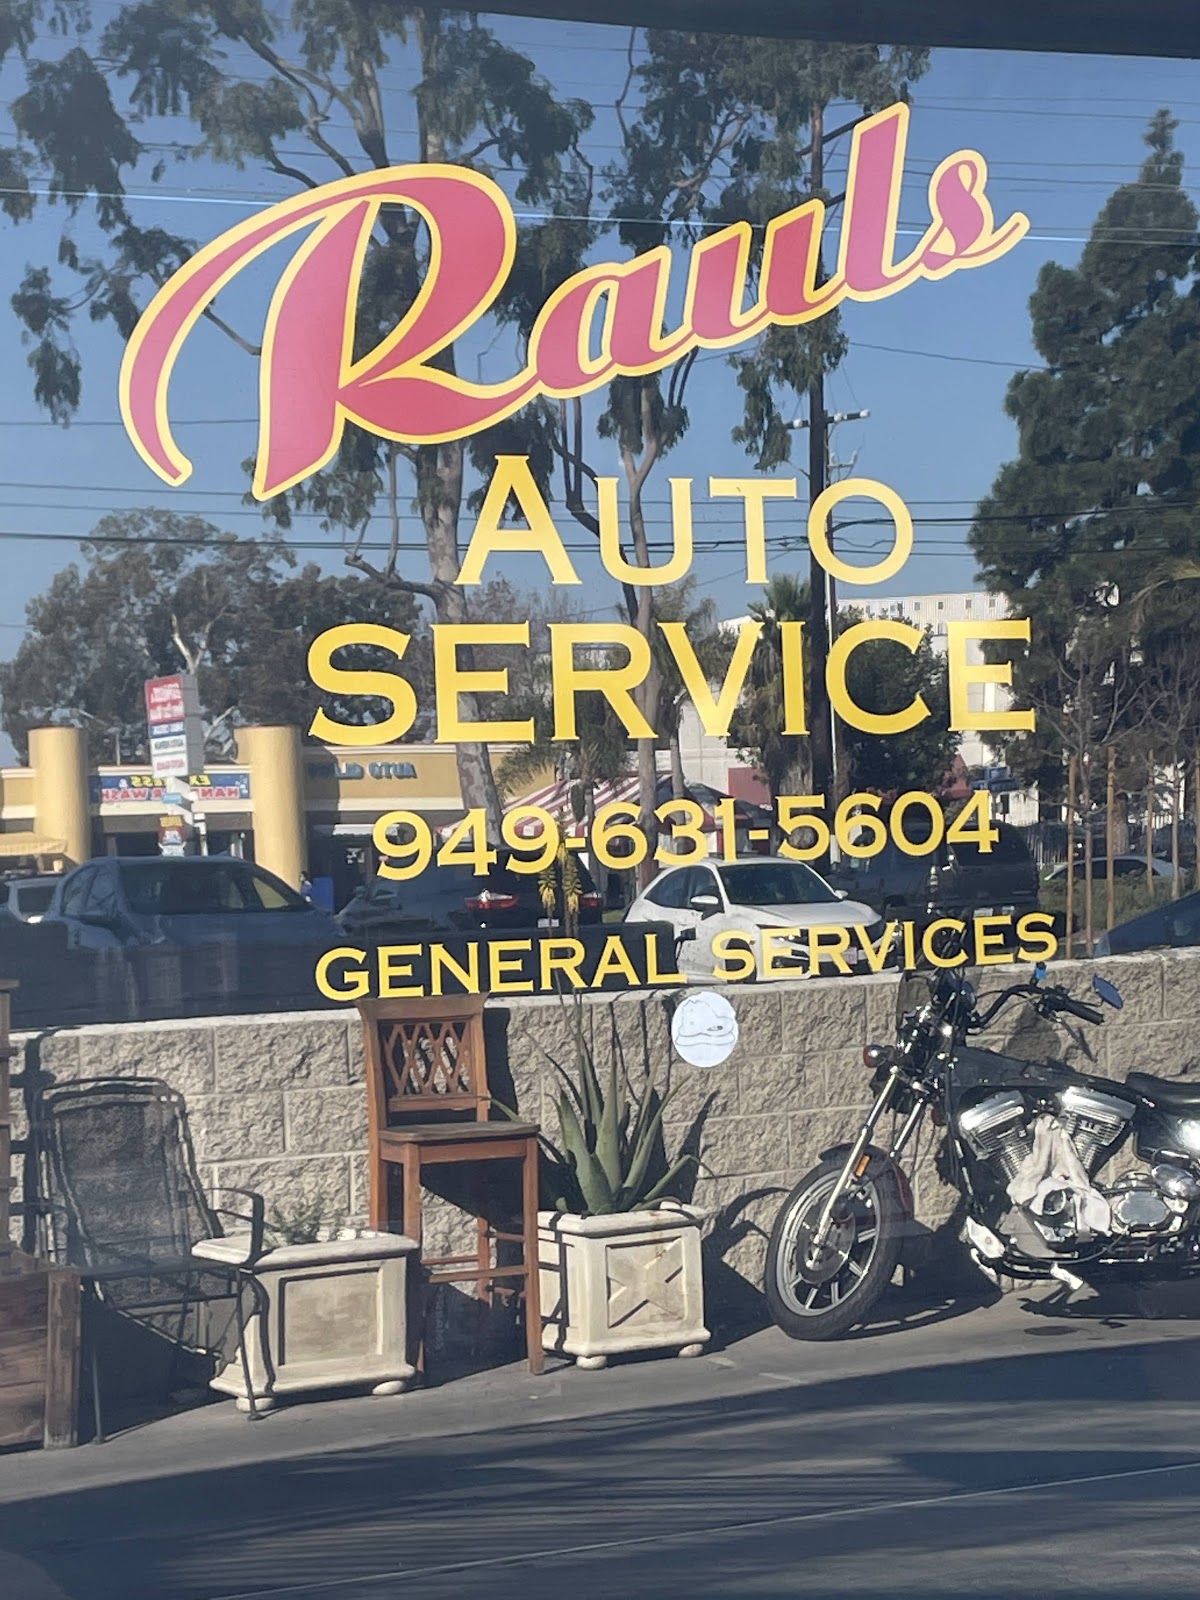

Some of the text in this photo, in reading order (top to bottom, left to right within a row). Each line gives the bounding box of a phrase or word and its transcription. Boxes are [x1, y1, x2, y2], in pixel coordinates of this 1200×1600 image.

[119, 101, 1031, 501] Rauls
[456, 455, 914, 586] AUTO
[307, 618, 1036, 748] SERVICE
[372, 789, 1000, 880] 949-631-5604
[315, 913, 1058, 1001] GENERAL SERVICES
